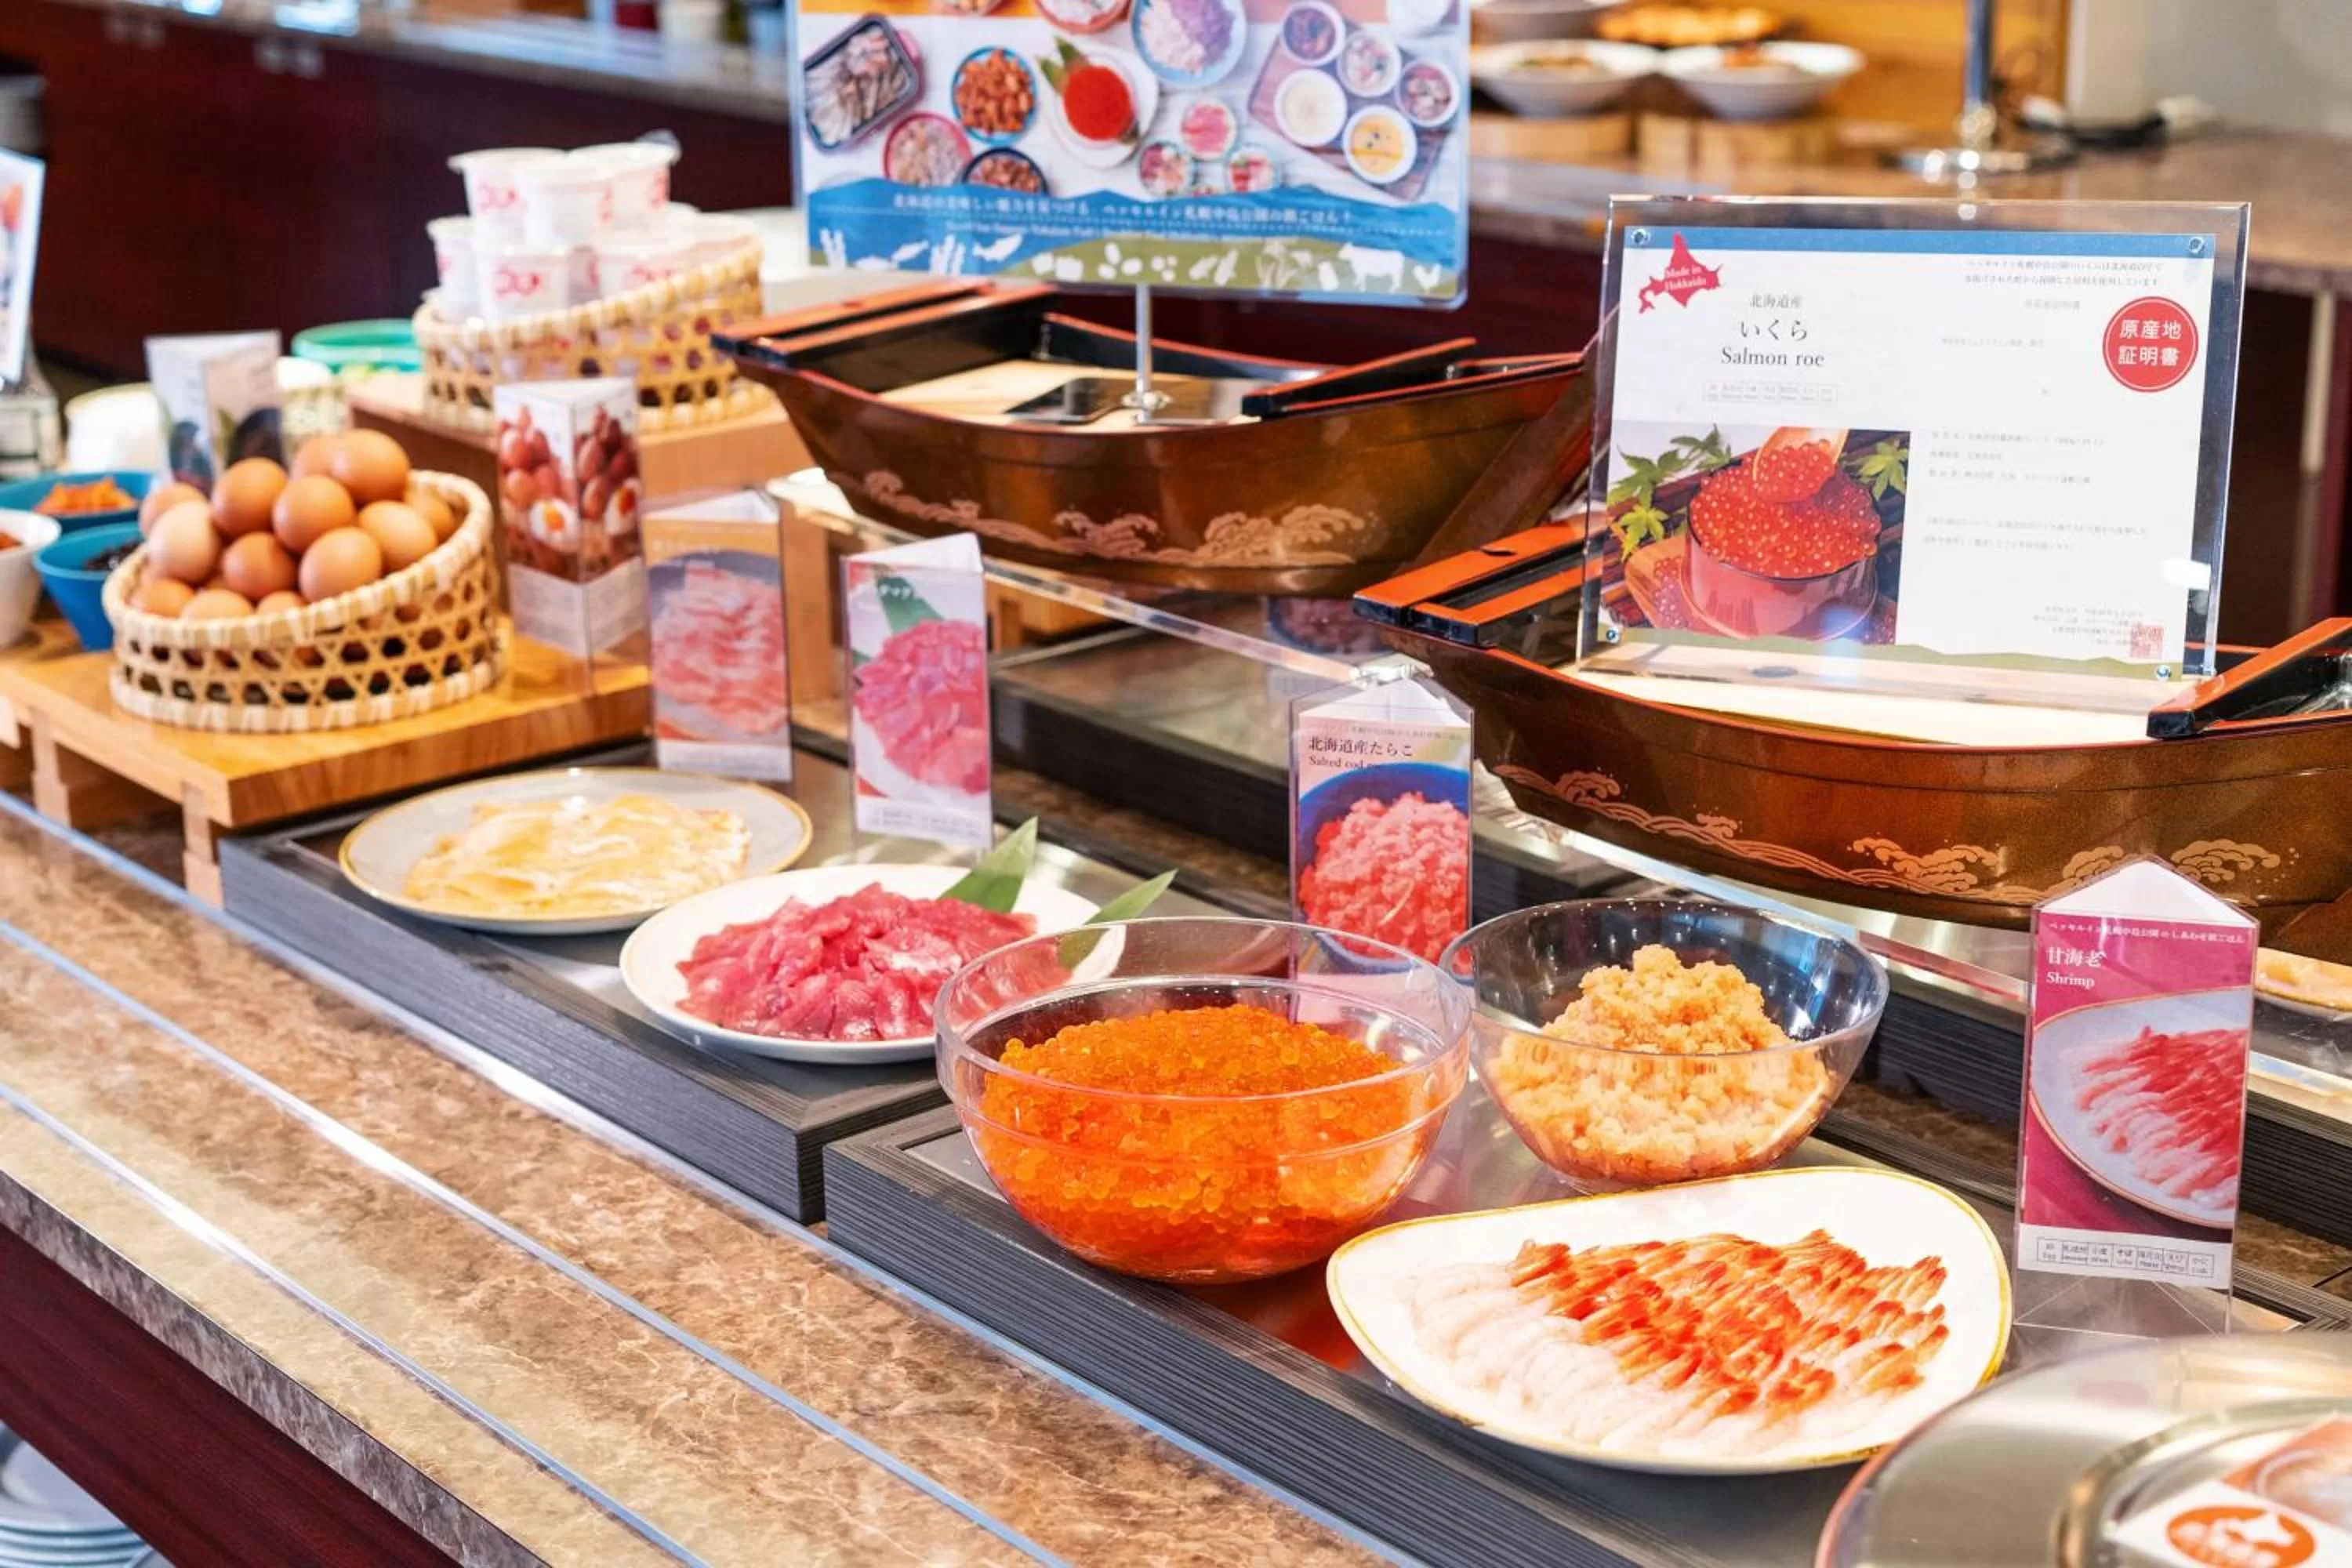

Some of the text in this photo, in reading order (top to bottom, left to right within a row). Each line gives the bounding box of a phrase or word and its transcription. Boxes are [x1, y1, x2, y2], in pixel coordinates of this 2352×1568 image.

[1740, 318, 1808, 341] いくら
[2119, 318, 2183, 340] 原産地
[1721, 346, 1826, 368] Salmon roe
[2118, 346, 2181, 366] 証明書
[1308, 735, 1414, 757] 北海道産たらこ
[2045, 946, 2106, 967] 甘海老
[2045, 971, 2096, 990] Shrimp
